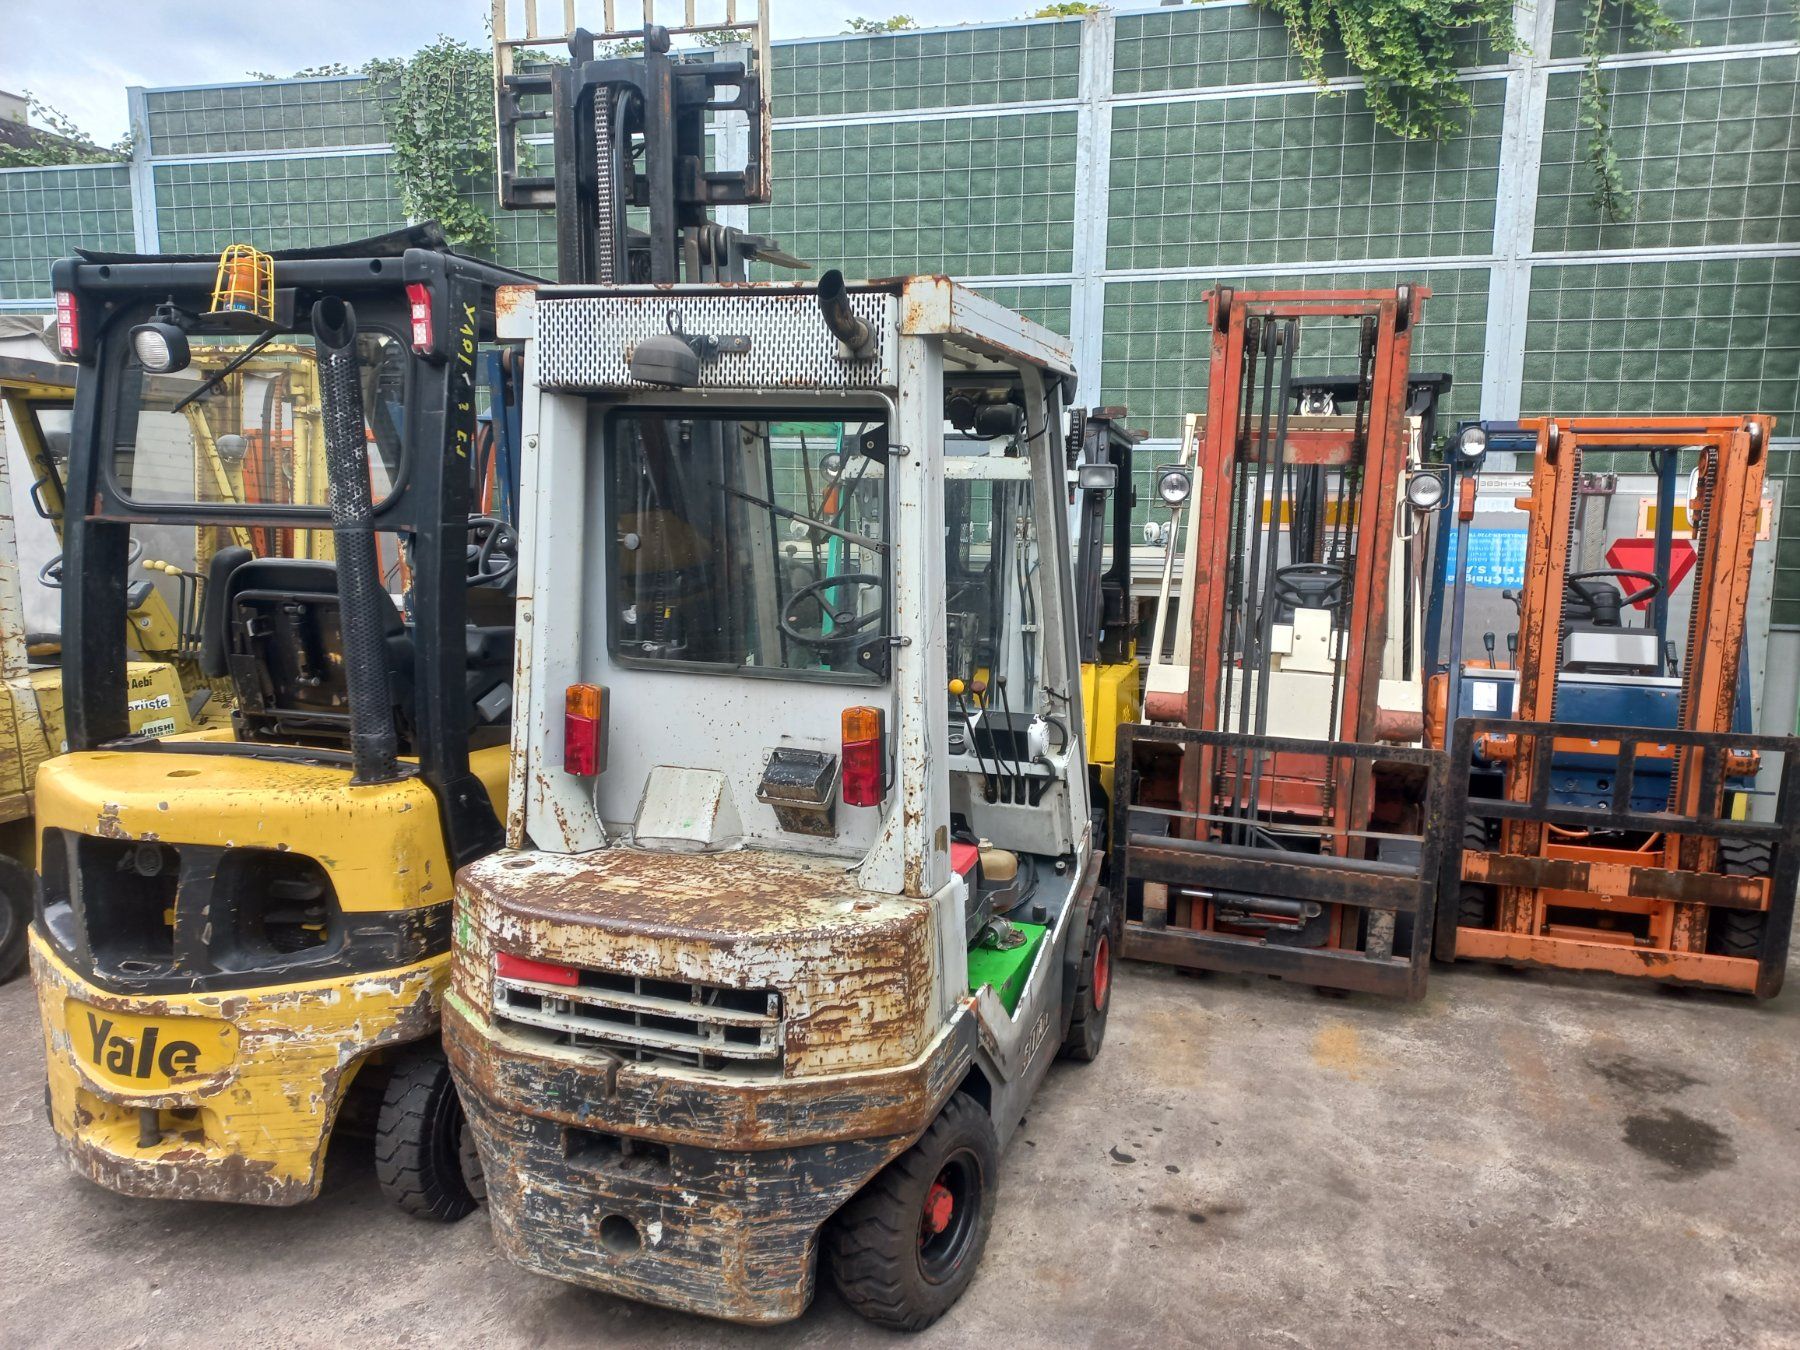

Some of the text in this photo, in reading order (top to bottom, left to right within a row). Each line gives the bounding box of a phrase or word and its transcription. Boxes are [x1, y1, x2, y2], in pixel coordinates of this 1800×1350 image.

[131, 676, 152, 689] Aebi
[127, 698, 168, 711] erüste
[139, 723, 174, 736] UBISHI
[87, 1012, 202, 1079] Yale
